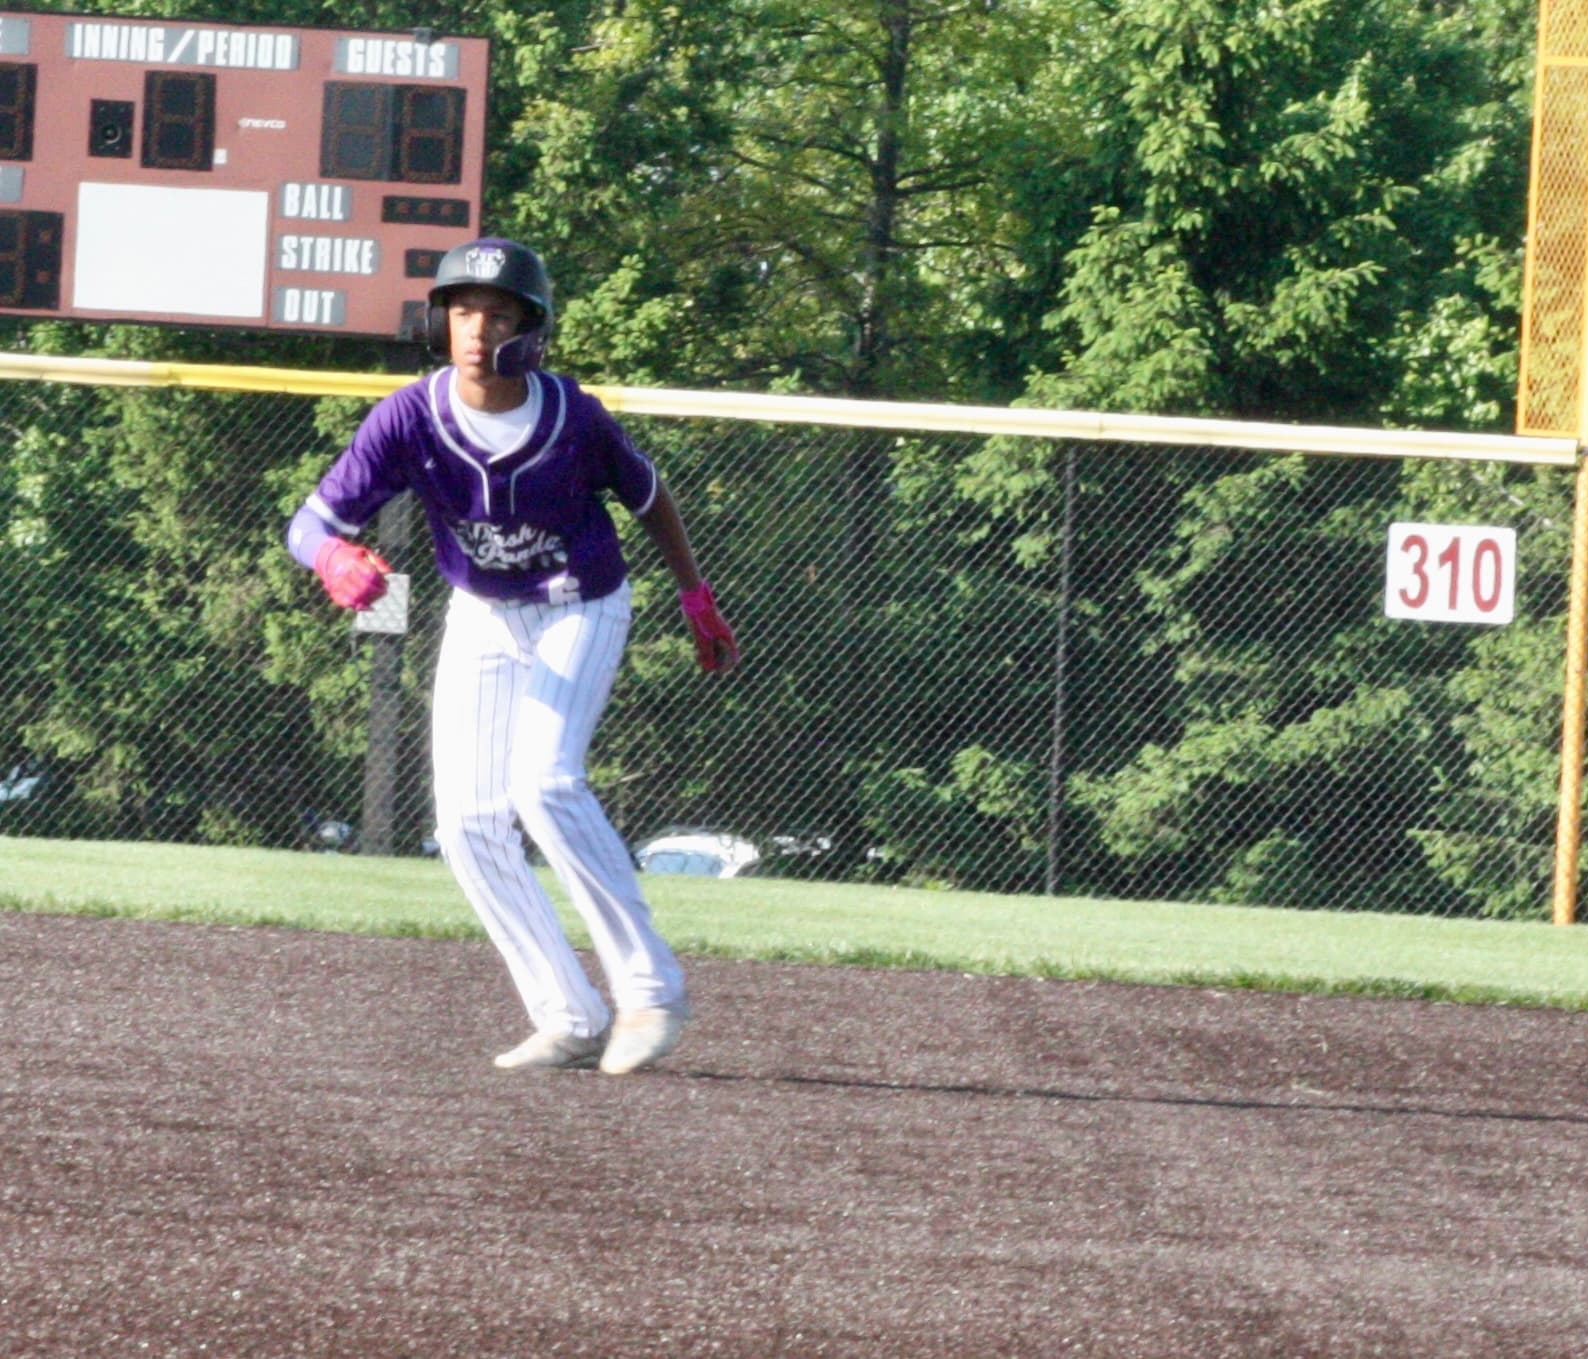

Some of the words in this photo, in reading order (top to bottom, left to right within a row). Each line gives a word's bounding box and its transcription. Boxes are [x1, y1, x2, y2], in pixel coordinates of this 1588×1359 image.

[347, 38, 446, 78] GUESTS
[284, 182, 344, 220] BALL
[280, 234, 374, 275] STRIKE
[283, 288, 335, 325] OUT
[1398, 533, 1503, 613] 310
